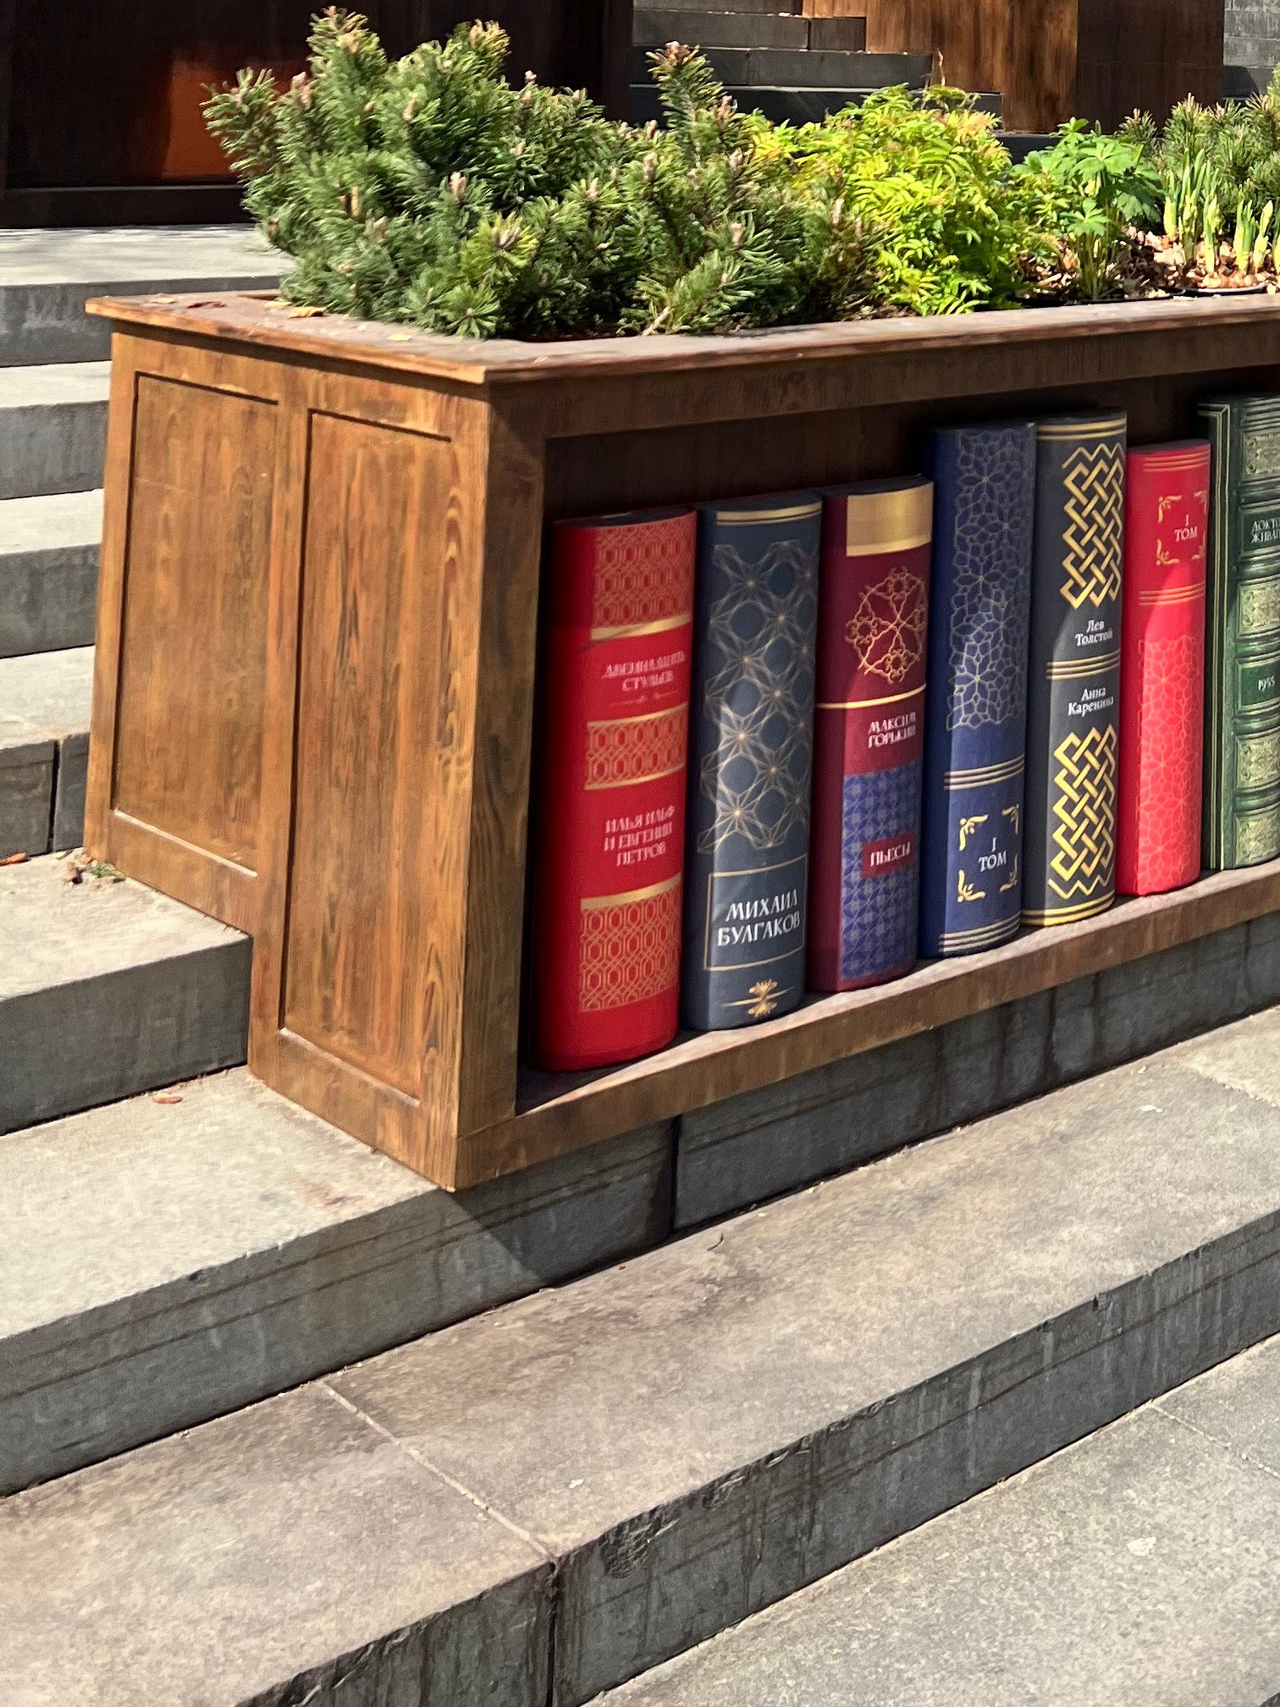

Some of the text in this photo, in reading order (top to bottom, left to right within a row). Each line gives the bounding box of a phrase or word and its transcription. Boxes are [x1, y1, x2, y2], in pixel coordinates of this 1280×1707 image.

[1174, 526, 1198, 542] ТОМ
[1074, 627, 1114, 647] Толстой
[1086, 619, 1105, 633] Лев
[1081, 687, 1107, 702] Анна
[1067, 696, 1114, 718] Каренина
[868, 711, 916, 735] МАКСИМ
[868, 724, 917, 749] ГОРЬКИЙ
[605, 805, 676, 834] ИЛЬЯ ИЛЬФ
[603, 821, 673, 852] И ЕВГЕНИЙ
[992, 837, 997, 852] I
[616, 841, 666, 867] ПЕТРОВ
[870, 841, 911, 867] ПЬЕСЫ
[978, 850, 1007, 872] ТОМ
[725, 888, 798, 922] МИХАИЛ
[717, 910, 801, 947] БУЛГАКОВ
